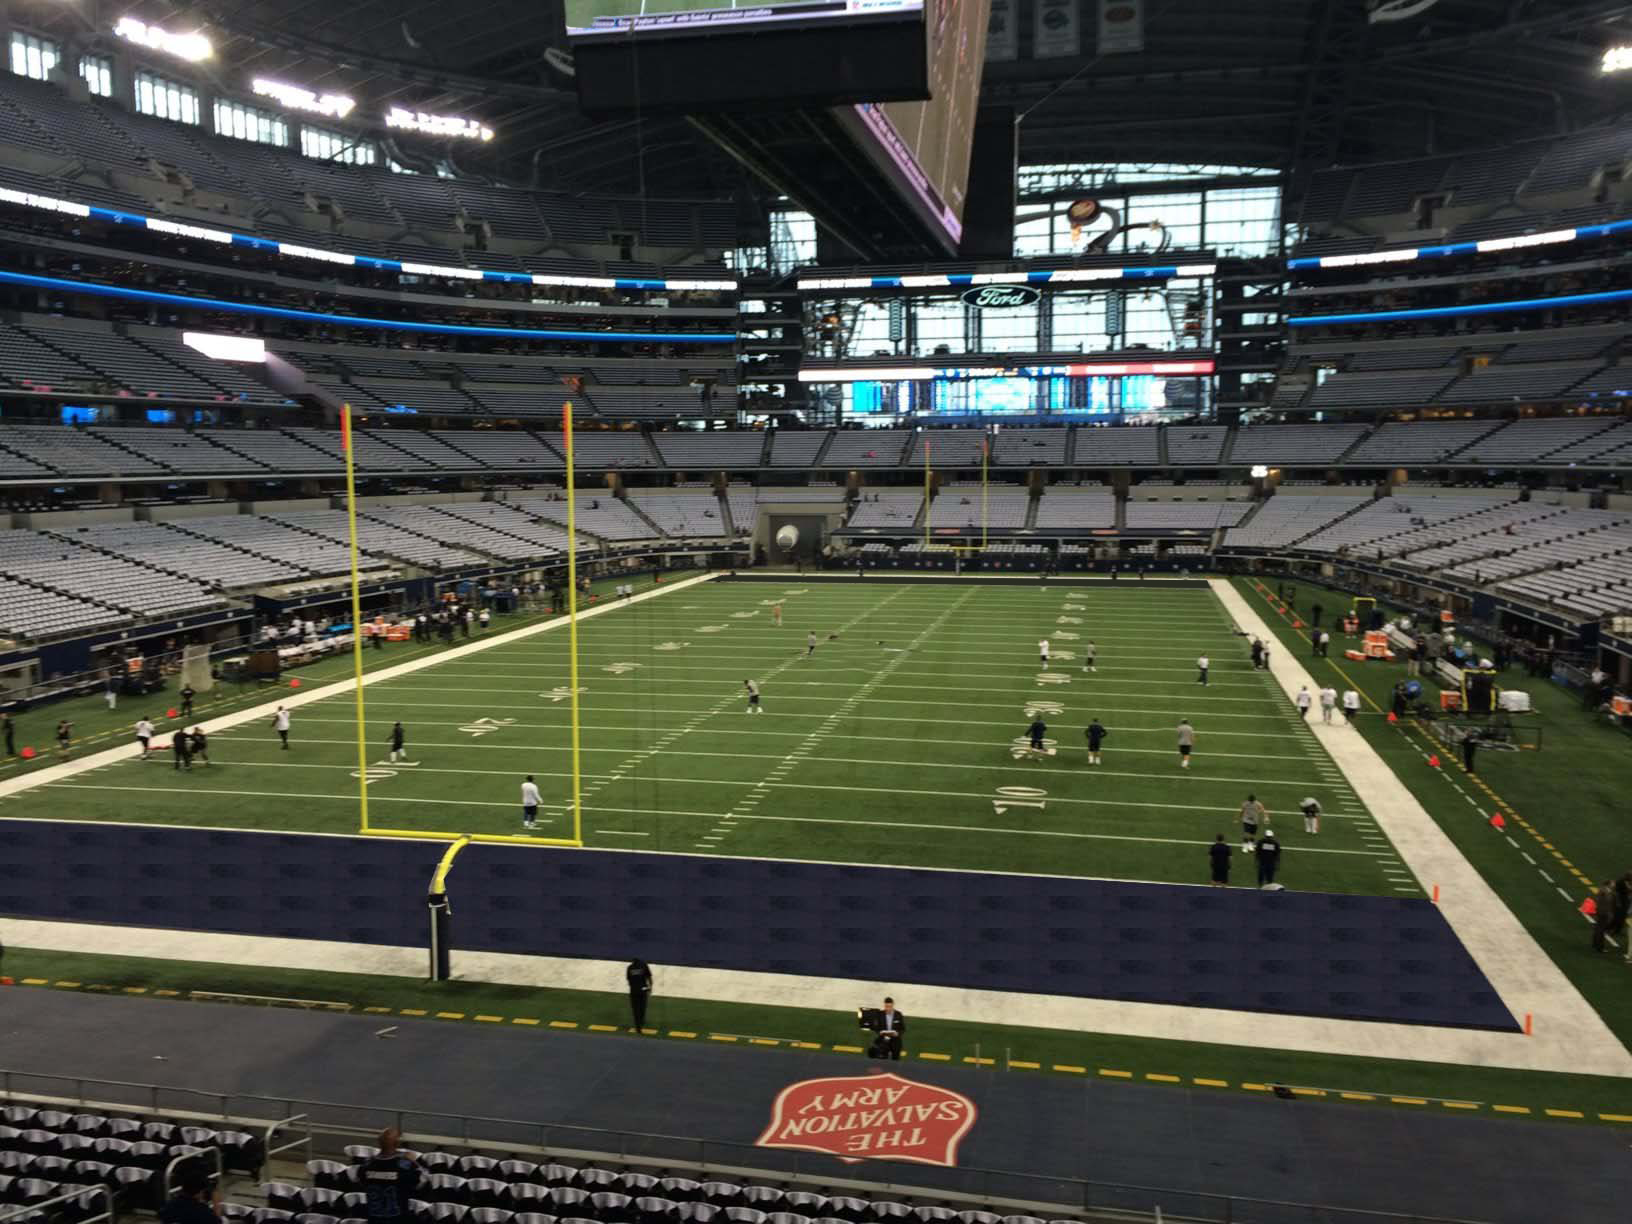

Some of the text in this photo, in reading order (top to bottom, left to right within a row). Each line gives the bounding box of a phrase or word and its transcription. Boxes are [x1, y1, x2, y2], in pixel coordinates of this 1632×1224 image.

[976, 288, 1026, 305] Ford
[992, 786, 1048, 809] 10
[799, 1085, 911, 1114] ARMY
[779, 1100, 963, 1139] SALVATION
[847, 1128, 927, 1151] THE
